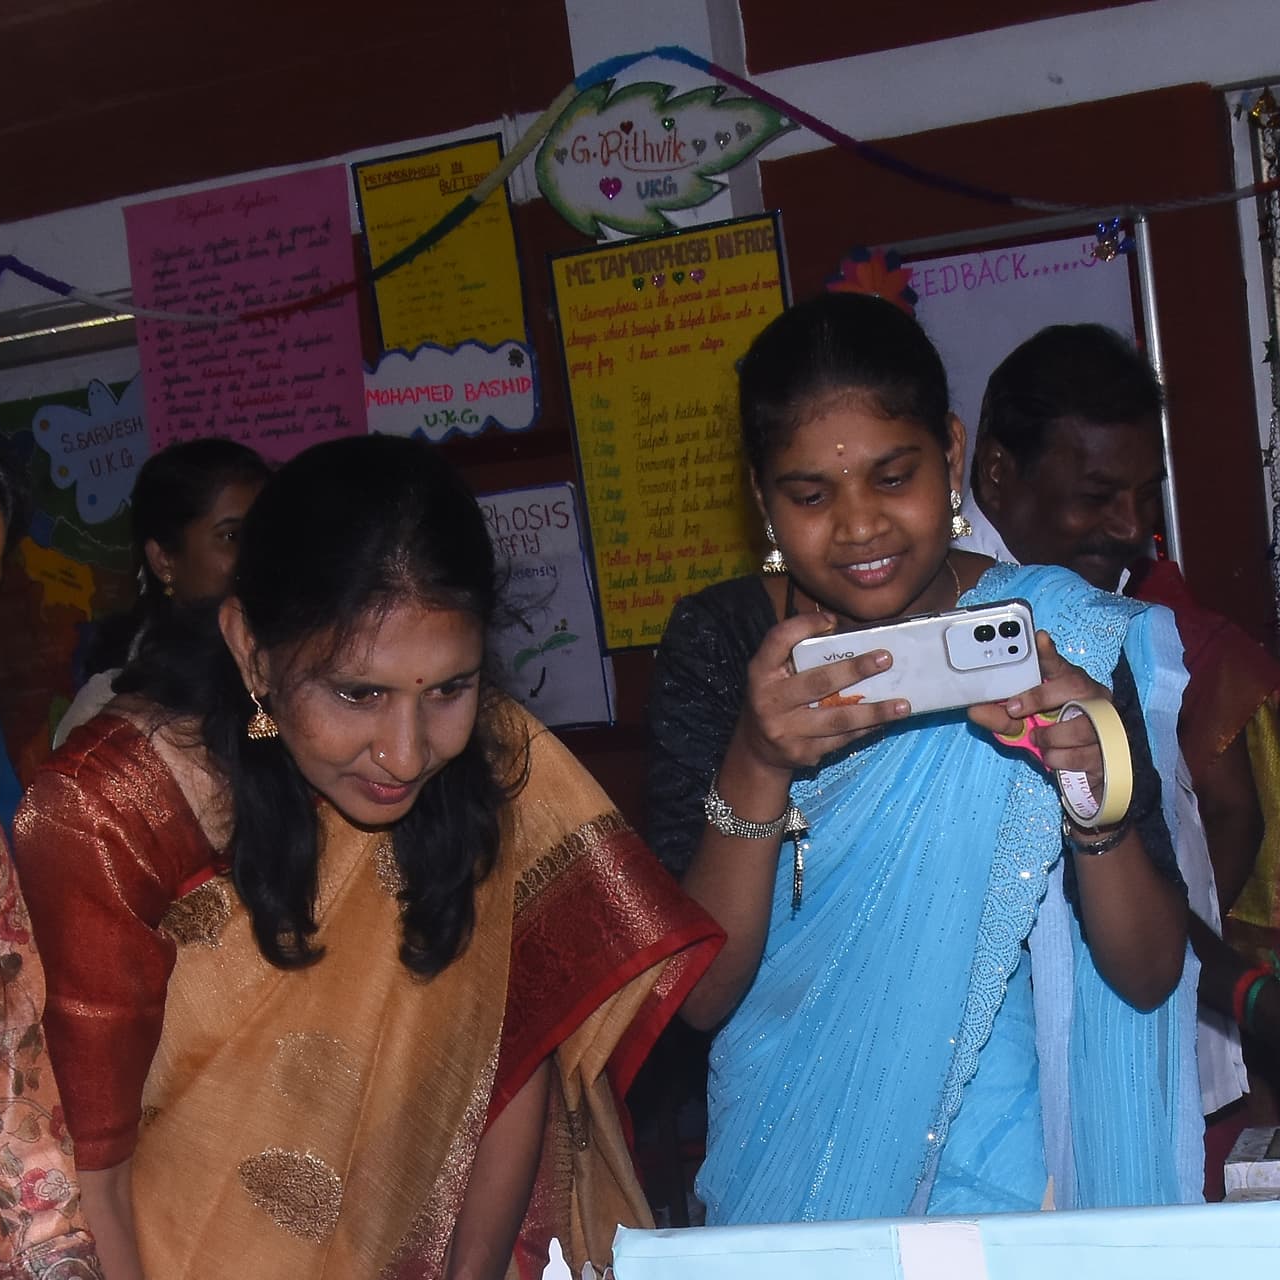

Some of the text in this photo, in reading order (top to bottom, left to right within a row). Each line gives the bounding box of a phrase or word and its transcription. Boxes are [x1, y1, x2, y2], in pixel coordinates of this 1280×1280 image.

[565, 238, 711, 287] METAMORPHOSIS
[366, 383, 454, 408] MOHAMED
[632, 384, 651, 408] Egg
[823, 650, 855, 662] vivo
